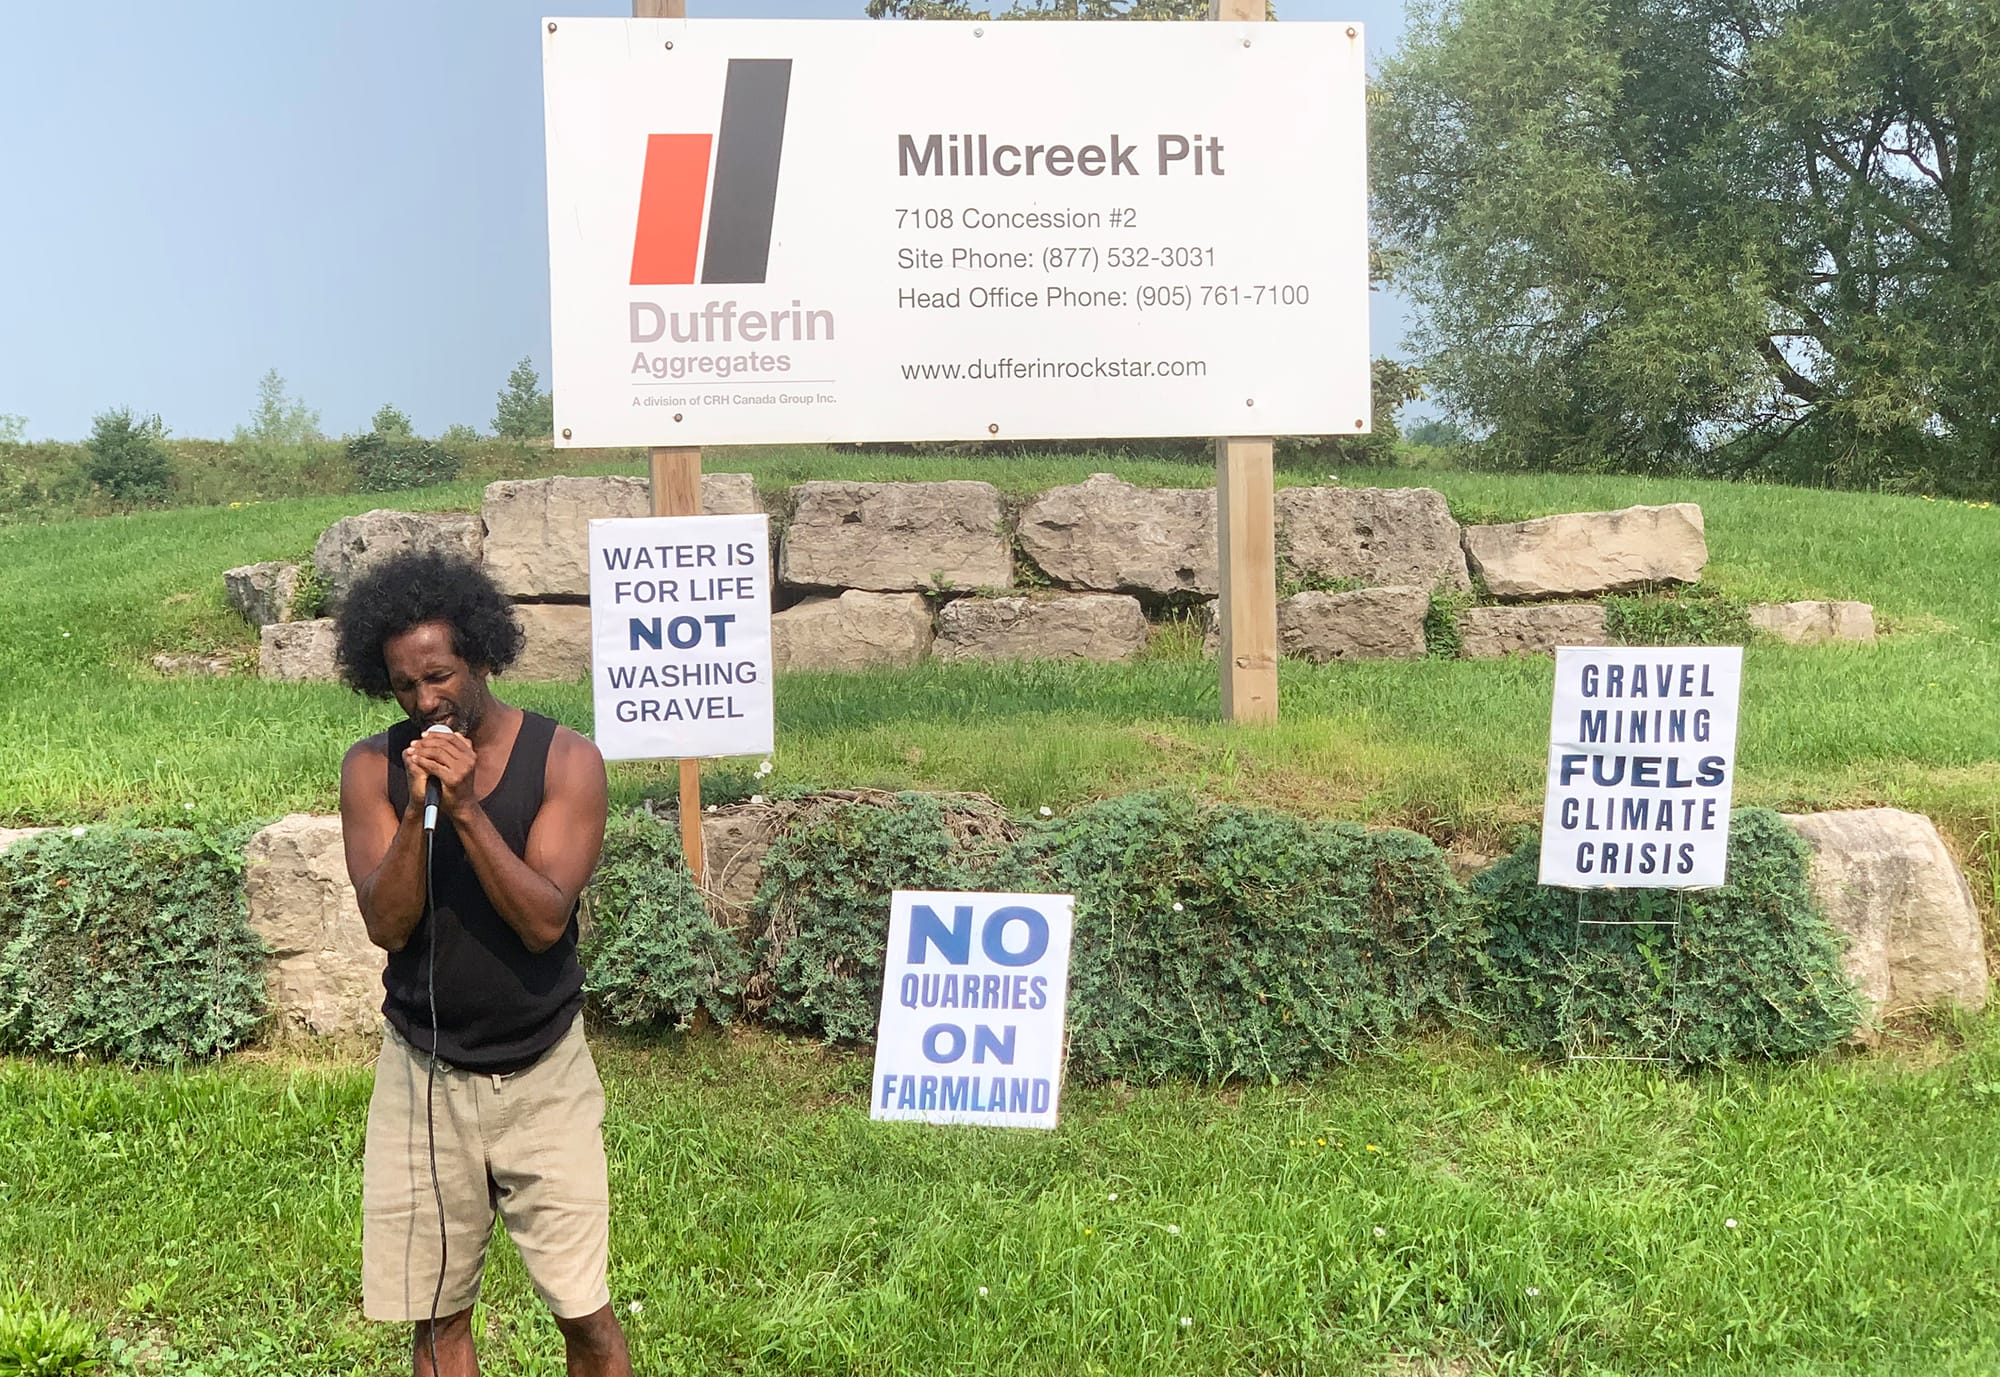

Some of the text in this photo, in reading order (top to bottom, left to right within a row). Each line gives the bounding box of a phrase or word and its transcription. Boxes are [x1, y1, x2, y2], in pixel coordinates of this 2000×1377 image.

[898, 134, 1224, 176] Millcreek Pit
[896, 208, 1136, 228] 7108 Concession #2
[898, 247, 1213, 272] Site Phone: (877) 532-3031
[899, 285, 1309, 311] Head Office Phone: (905) 761-7100
[630, 300, 834, 343] Dufferin
[631, 351, 791, 379] Aggregates
[901, 357, 1206, 379] www.dufferinrockstar.com
[632, 393, 837, 407] A division of CRH Canada Group Inc.
[603, 543, 754, 570] WATER IS
[615, 577, 754, 604] FOR LIFE
[629, 614, 735, 650] NOT
[608, 662, 756, 689] WASHING
[1582, 664, 1714, 698] GRAVEL
[616, 696, 744, 722] GRAVEL
[1580, 709, 1710, 743] MINING
[1560, 755, 1725, 788] FUELS
[1561, 798, 1716, 831] CLIMATE
[1576, 842, 1694, 874] CRISIS
[907, 905, 1049, 967] NO
[900, 973, 1047, 1010] QUARRIES
[922, 1023, 1016, 1065] ON
[881, 1074, 1050, 1114] FARMLAND
